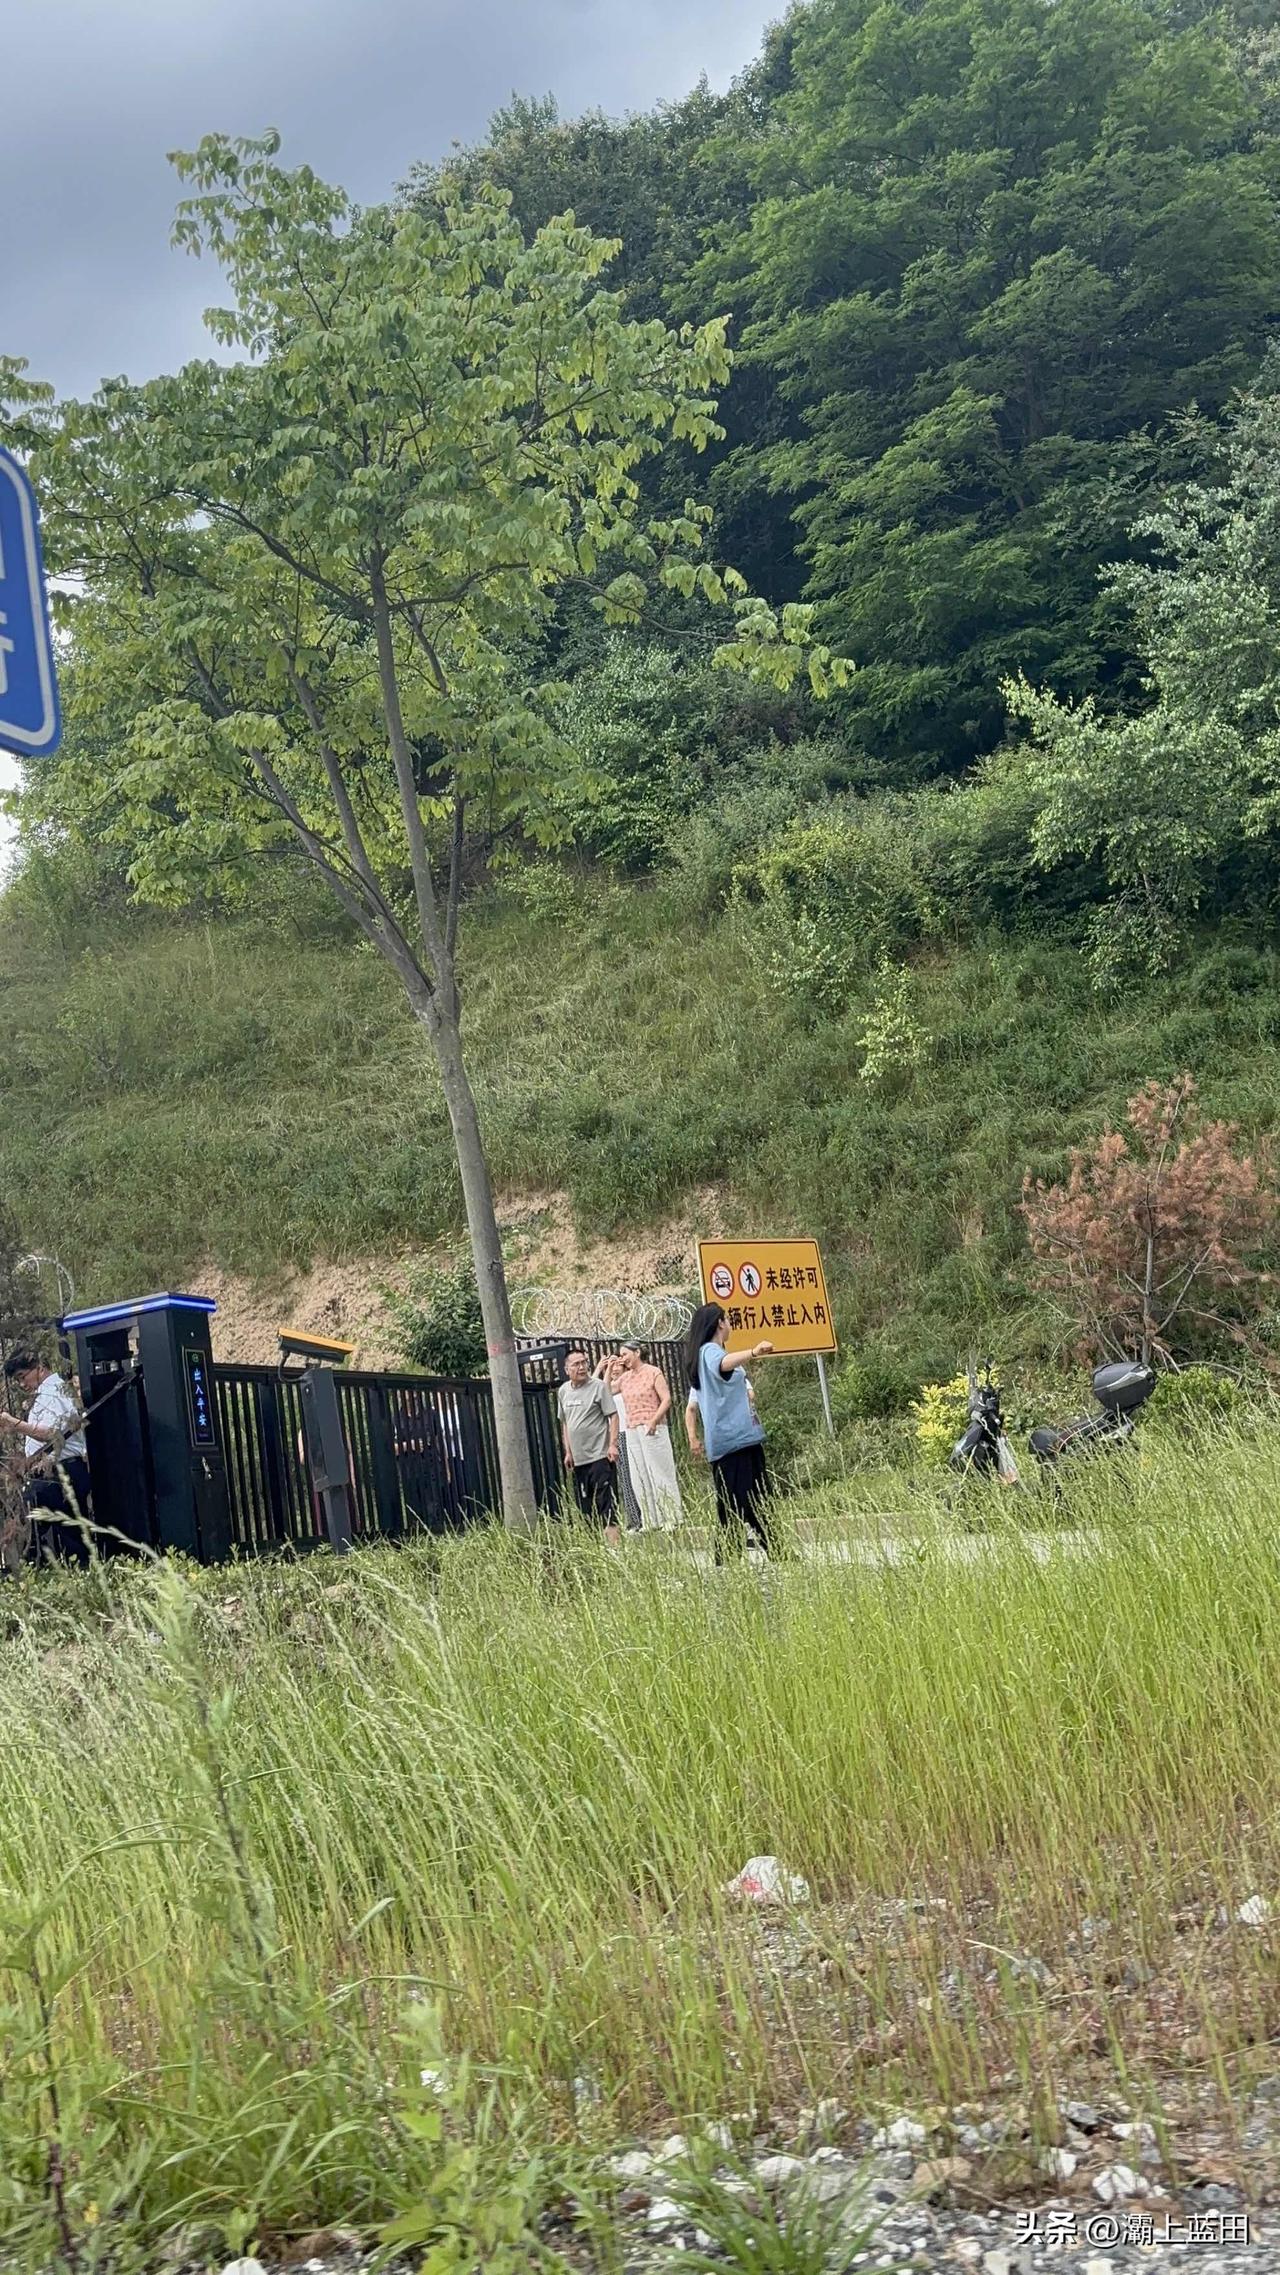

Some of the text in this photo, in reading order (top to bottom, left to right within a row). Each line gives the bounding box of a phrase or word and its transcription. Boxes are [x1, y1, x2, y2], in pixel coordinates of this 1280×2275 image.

[766, 1267, 818, 1290] 未经许可
[728, 1302, 826, 1330] 辆行人禁止入内
[194, 1368, 207, 1426] 出入平安
